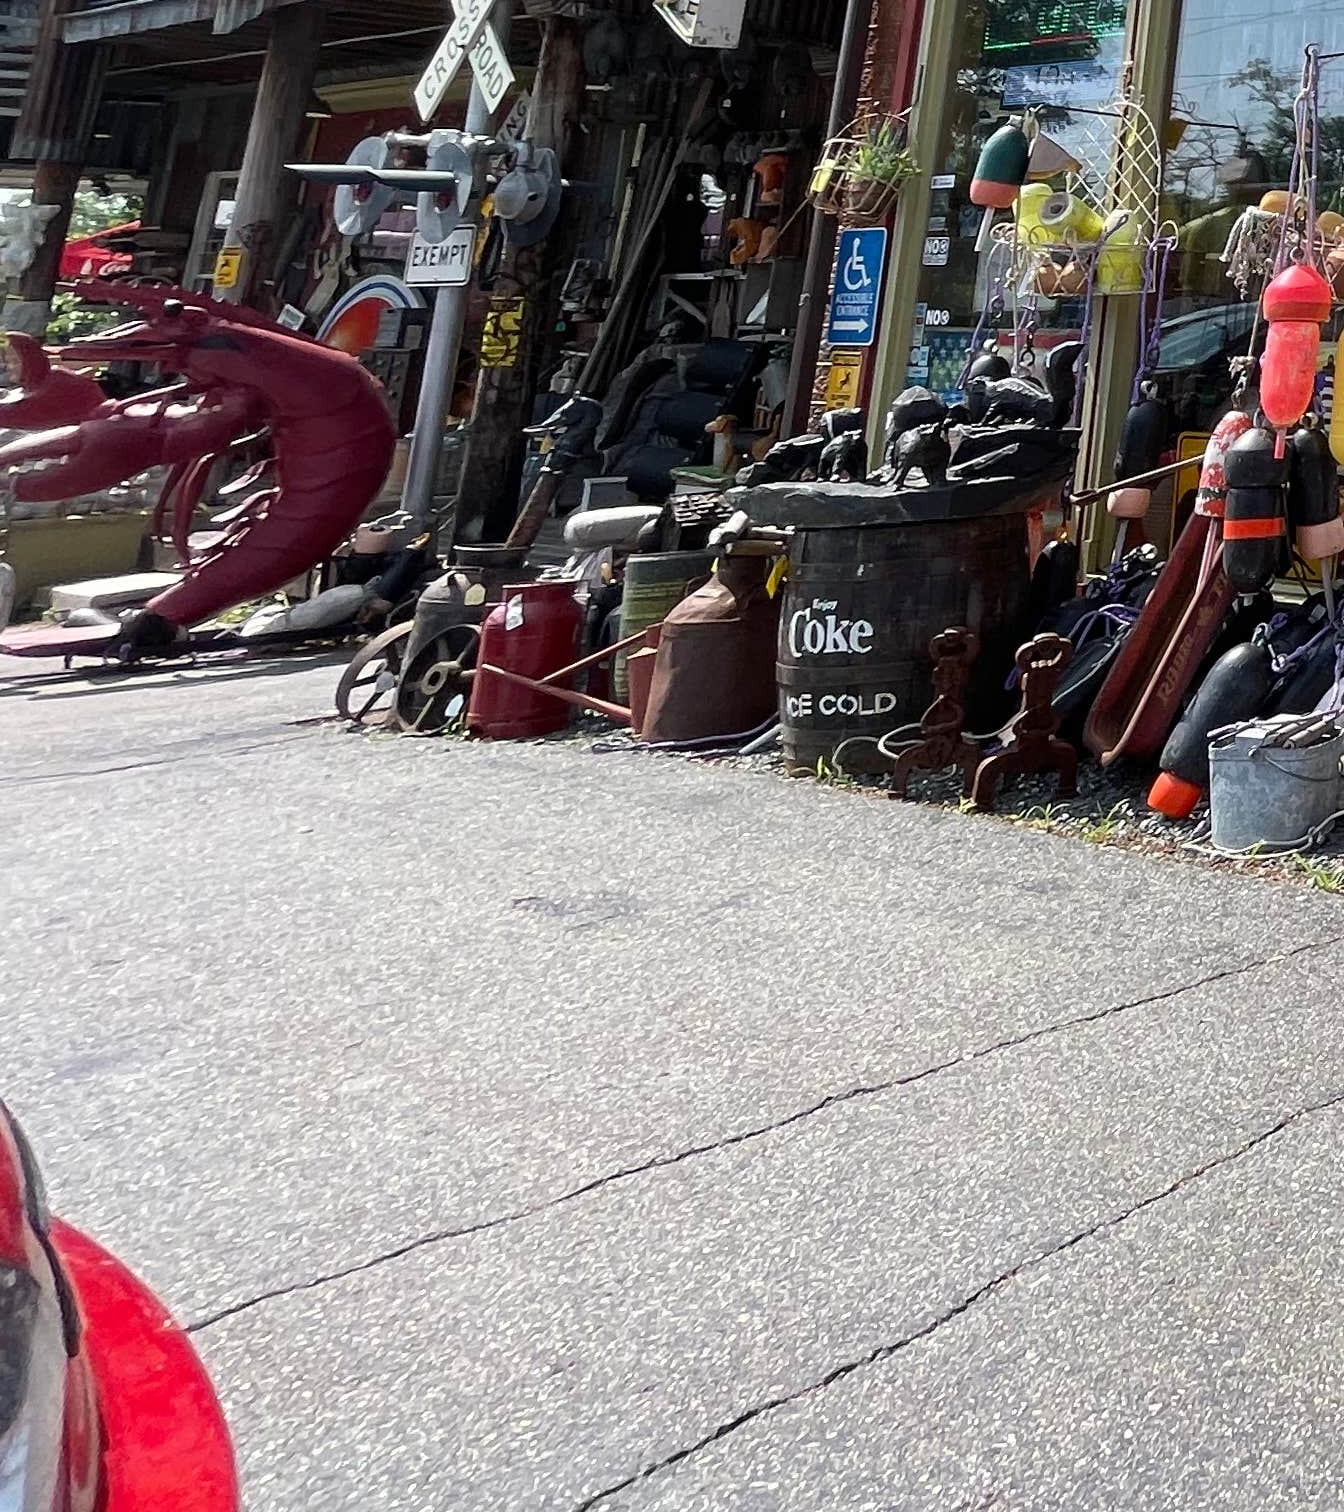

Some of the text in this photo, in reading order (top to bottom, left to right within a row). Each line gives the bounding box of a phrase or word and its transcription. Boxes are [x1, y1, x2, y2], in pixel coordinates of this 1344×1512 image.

[473, 33, 504, 100] ROAD
[412, 244, 468, 267] EXEMPT
[788, 607, 874, 658] Coke
[818, 692, 897, 716] COLD
